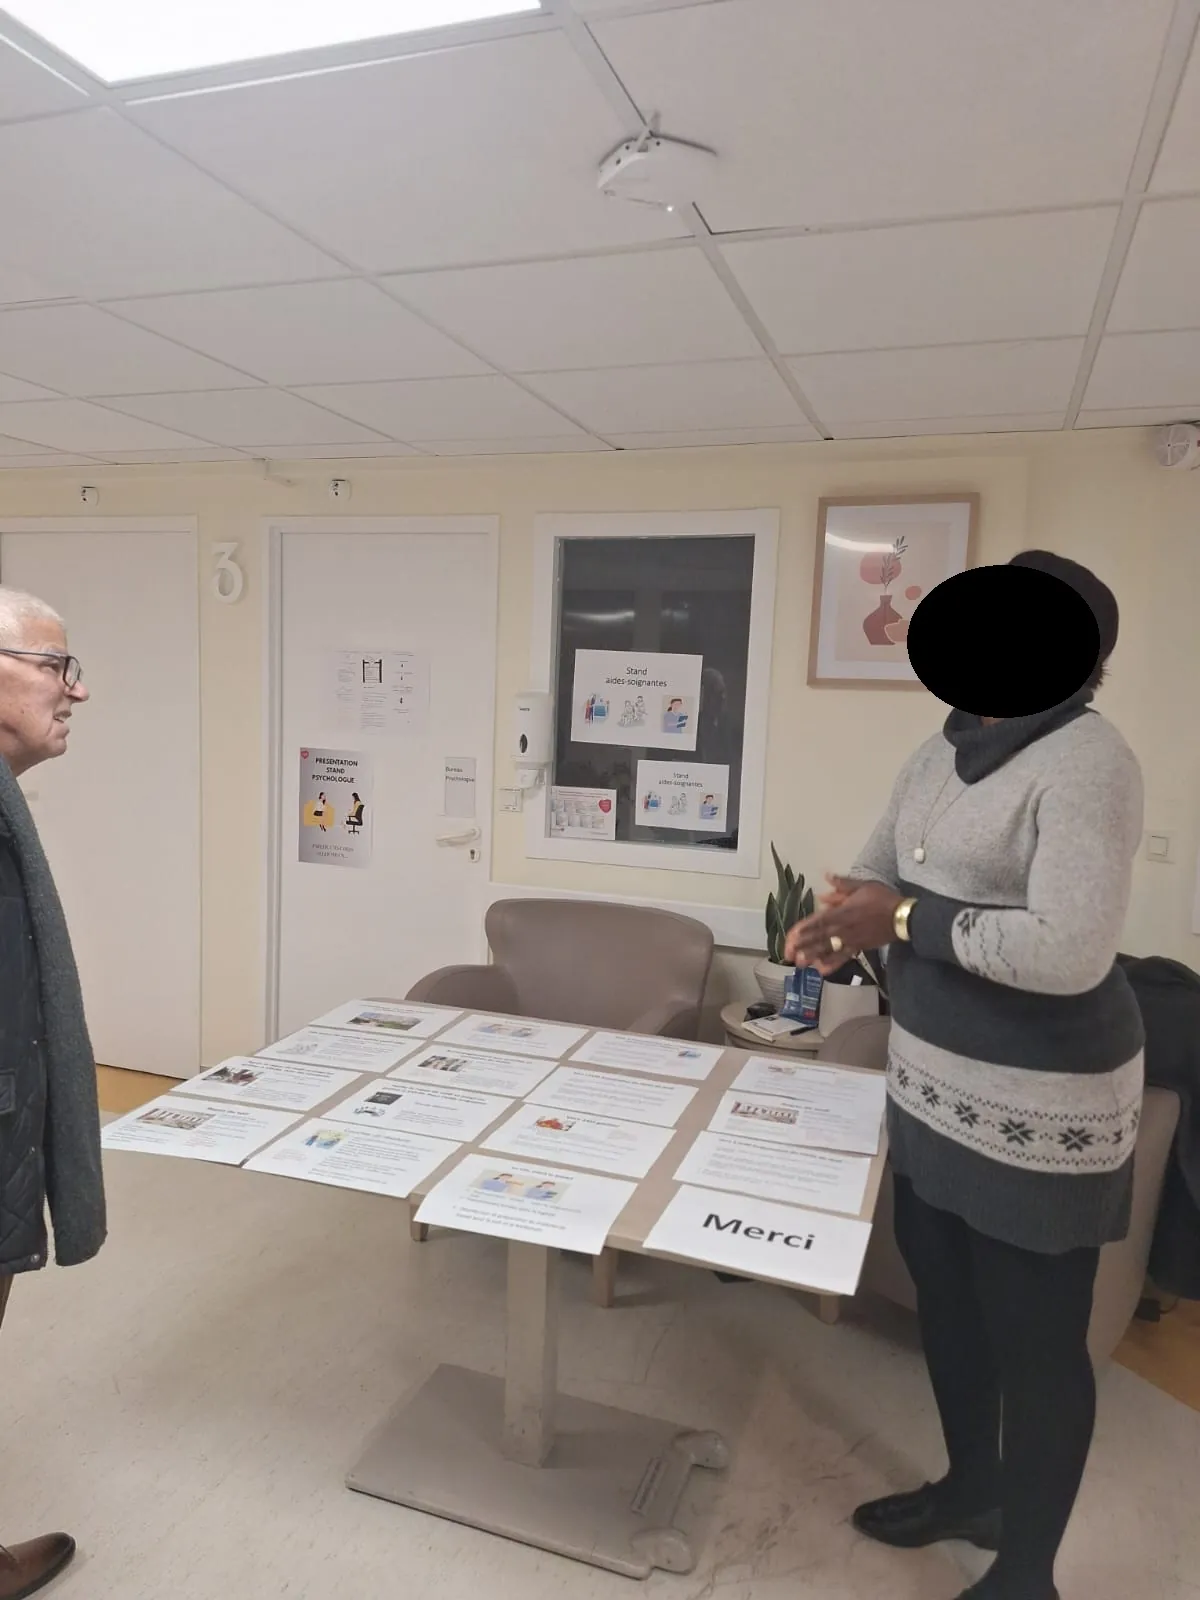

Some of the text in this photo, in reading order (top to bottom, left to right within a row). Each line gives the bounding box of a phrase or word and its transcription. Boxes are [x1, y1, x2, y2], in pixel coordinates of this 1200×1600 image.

[210, 541, 243, 603] 3
[626, 666, 648, 676] Stand
[605, 677, 668, 688] aides-soignantes
[315, 757, 358, 767] PRESENTATION
[326, 766, 346, 774] STAND
[311, 774, 355, 784] PSYCHOLOGUE
[702, 1213, 816, 1251] Merci
